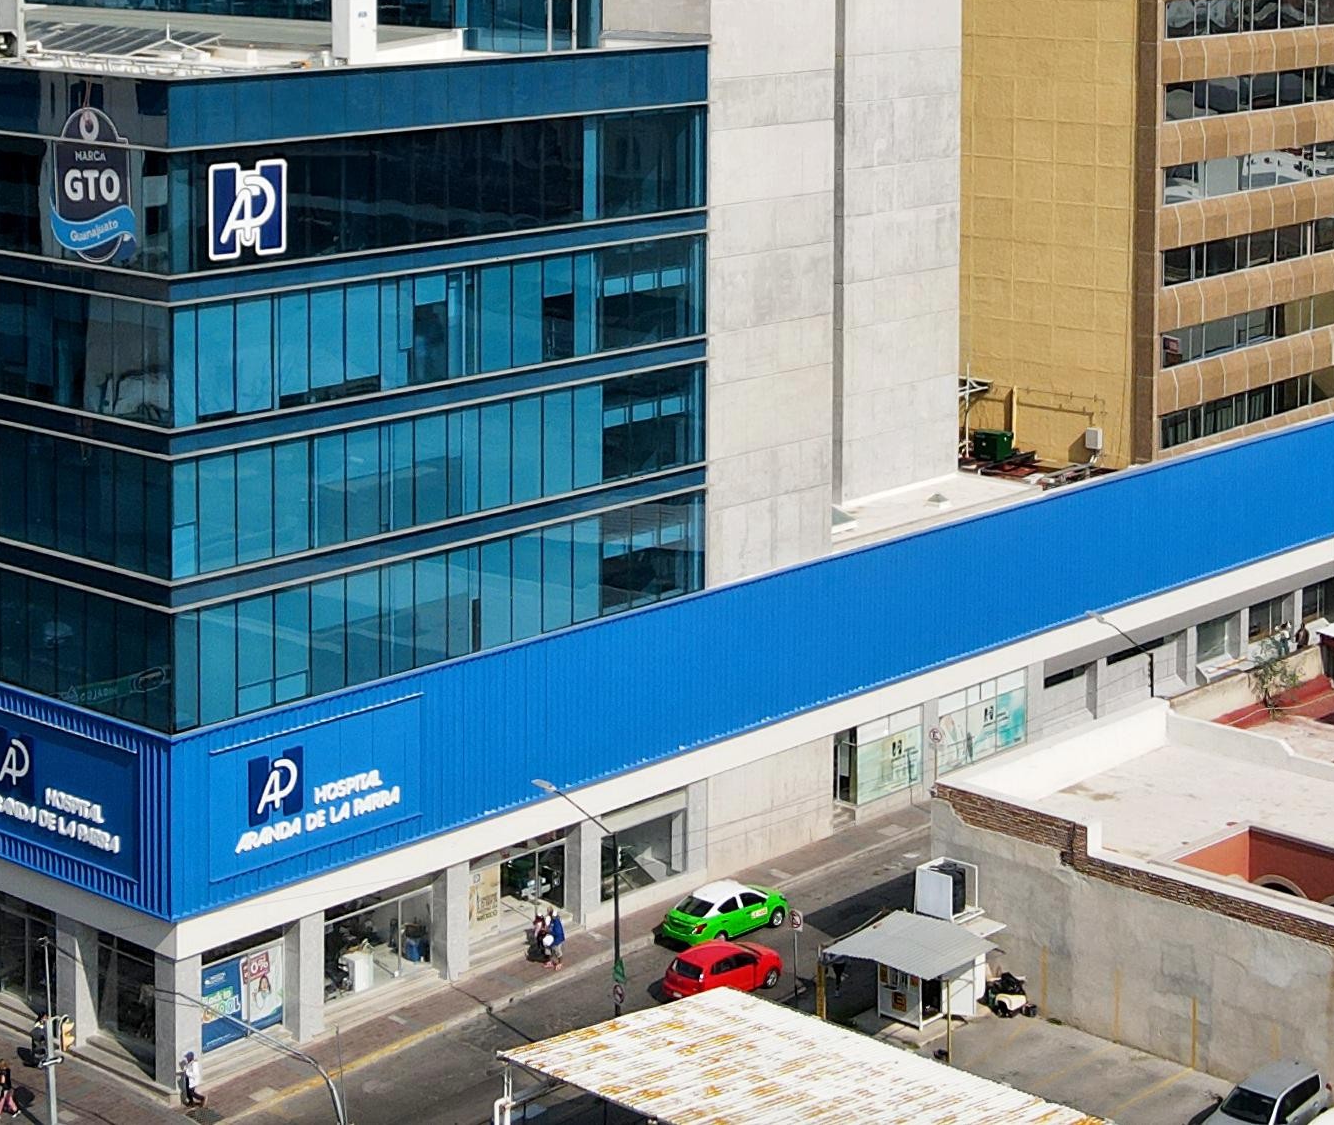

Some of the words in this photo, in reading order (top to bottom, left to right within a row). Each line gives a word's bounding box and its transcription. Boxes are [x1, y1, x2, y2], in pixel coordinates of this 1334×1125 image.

[74, 150, 107, 162] MARCA
[64, 168, 121, 202] GTO
[314, 769, 383, 805] HOSPITAL
[45, 787, 105, 824] HOSPITAL
[234, 817, 302, 854] ARANDA
[305, 809, 327, 832] DE
[329, 801, 351, 824] LA
[352, 786, 401, 817] PARRA
[38, 809, 57, 831] DE
[58, 816, 77, 838] LA
[77, 823, 120, 854] PARRA
